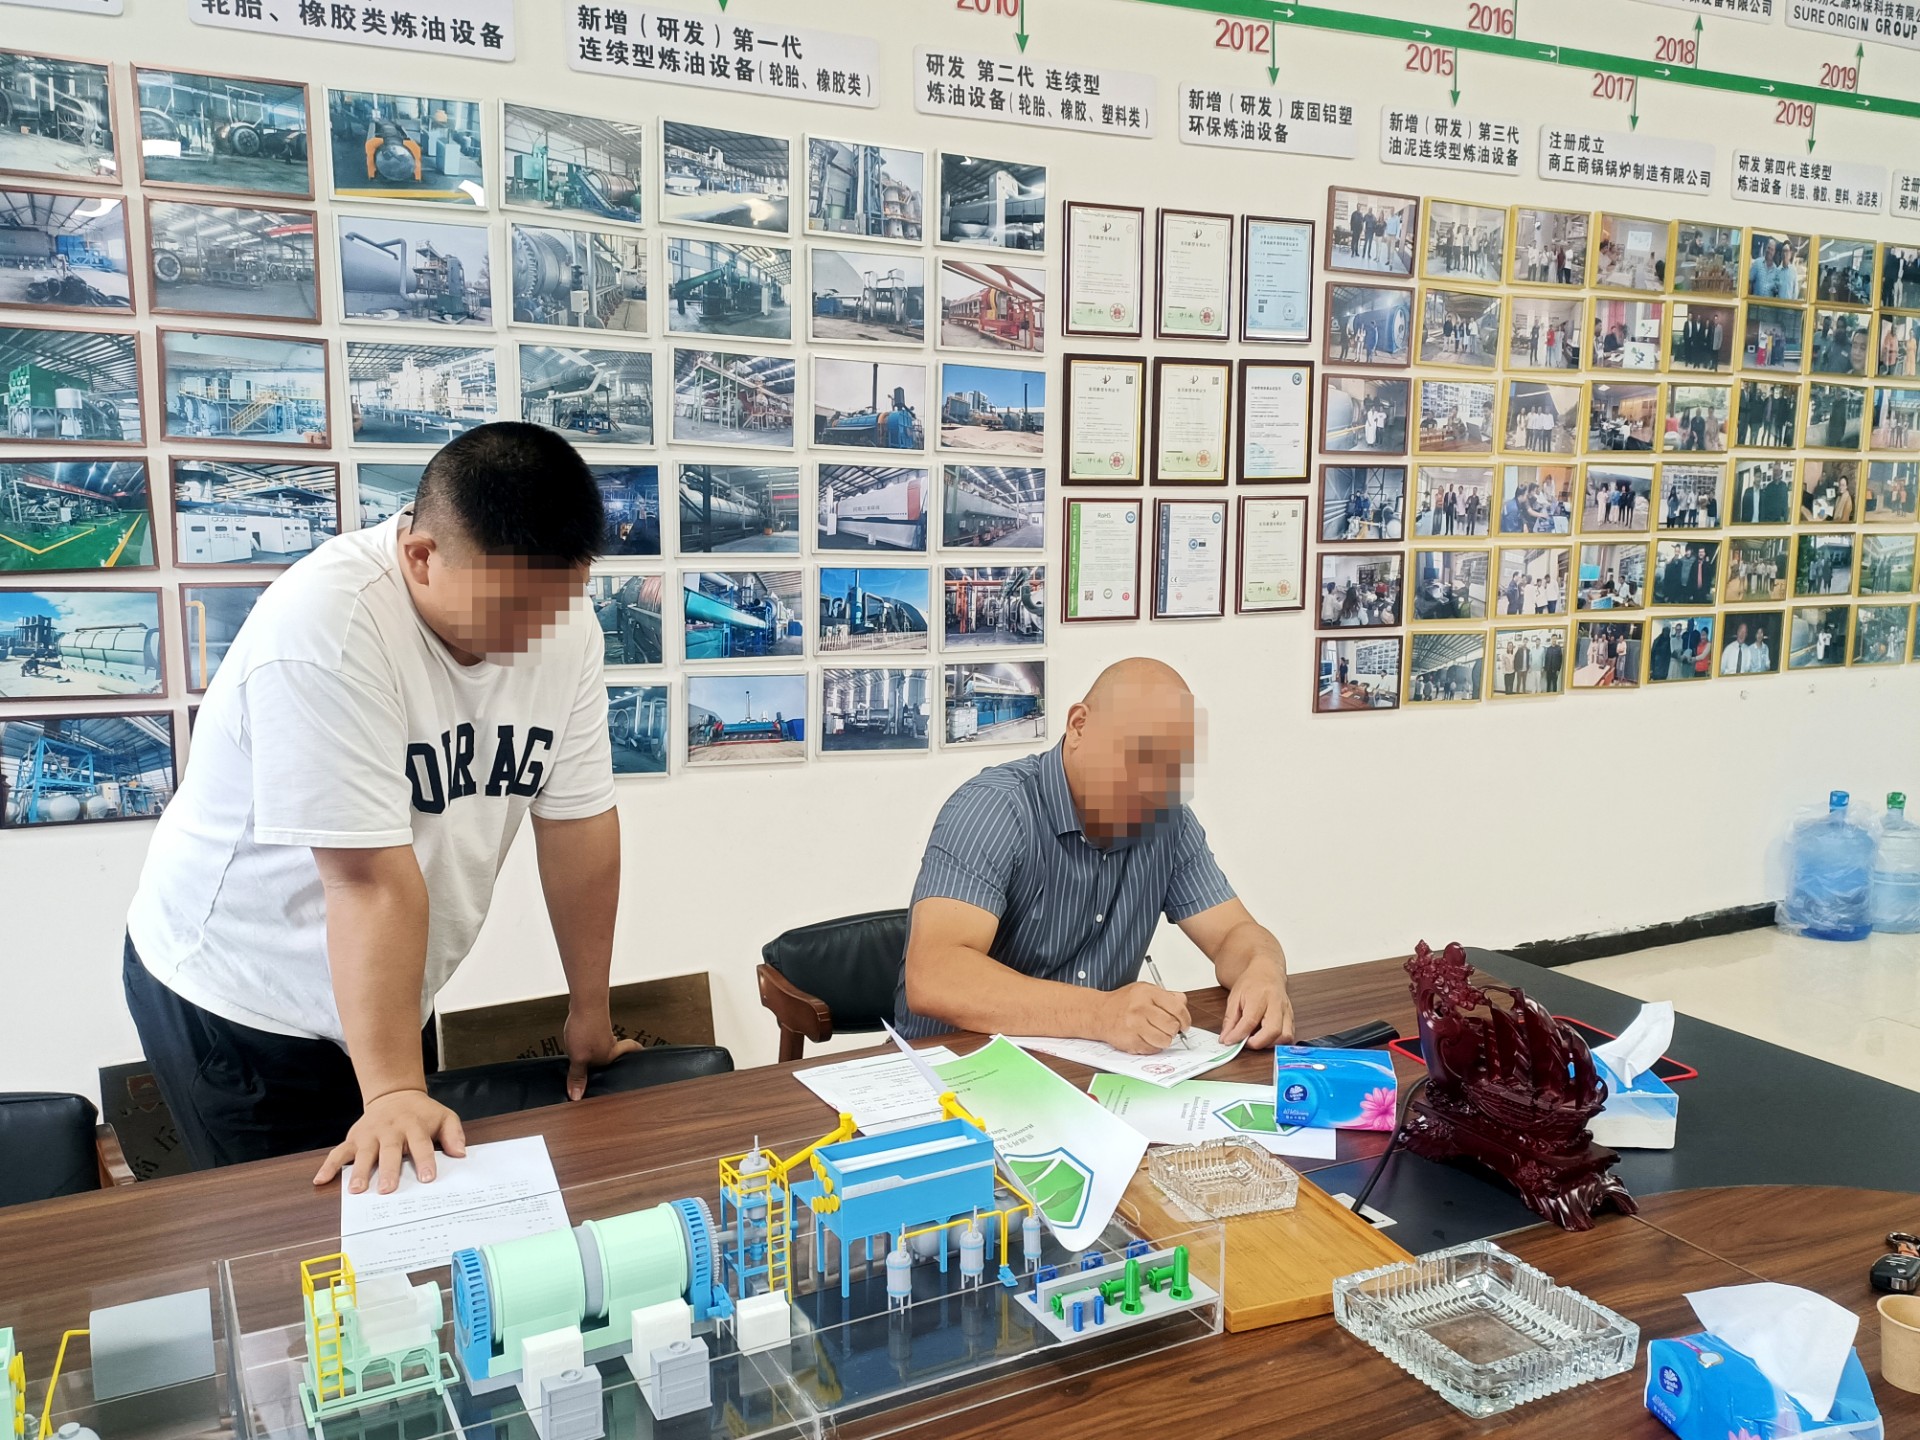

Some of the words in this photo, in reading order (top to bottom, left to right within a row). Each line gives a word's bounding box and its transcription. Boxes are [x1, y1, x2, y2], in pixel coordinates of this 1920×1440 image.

[577, 5, 803, 59] 新增（研发）第一代
[1468, 3, 1514, 35] 2016
[1793, 5, 1825, 24] SURE
[1828, 12, 1869, 31] ORIGIN
[1875, 18, 1918, 40] GROUP
[1215, 19, 1269, 53] 2012
[1655, 35, 1696, 64] 2018
[926, 53, 965, 79] 研发
[977, 59, 1034, 88] 第二代
[1046, 69, 1100, 96] 连续型
[1406, 43, 1454, 76] 2015
[1593, 72, 1635, 102] 2017
[1820, 63, 1857, 90] 2019
[1188, 115, 1289, 143] 环保炼油设备
[1775, 100, 1813, 128] 2019
[1388, 136, 1519, 167] 油泥连续型炼油设备
[1549, 131, 1605, 154] 注册成立
[1548, 153, 1711, 188] 商丘商锅锅炉制造有限公司
[1738, 155, 1761, 173] 研发
[1764, 157, 1797, 177] 第四代
[1799, 162, 1832, 181] 连续型
